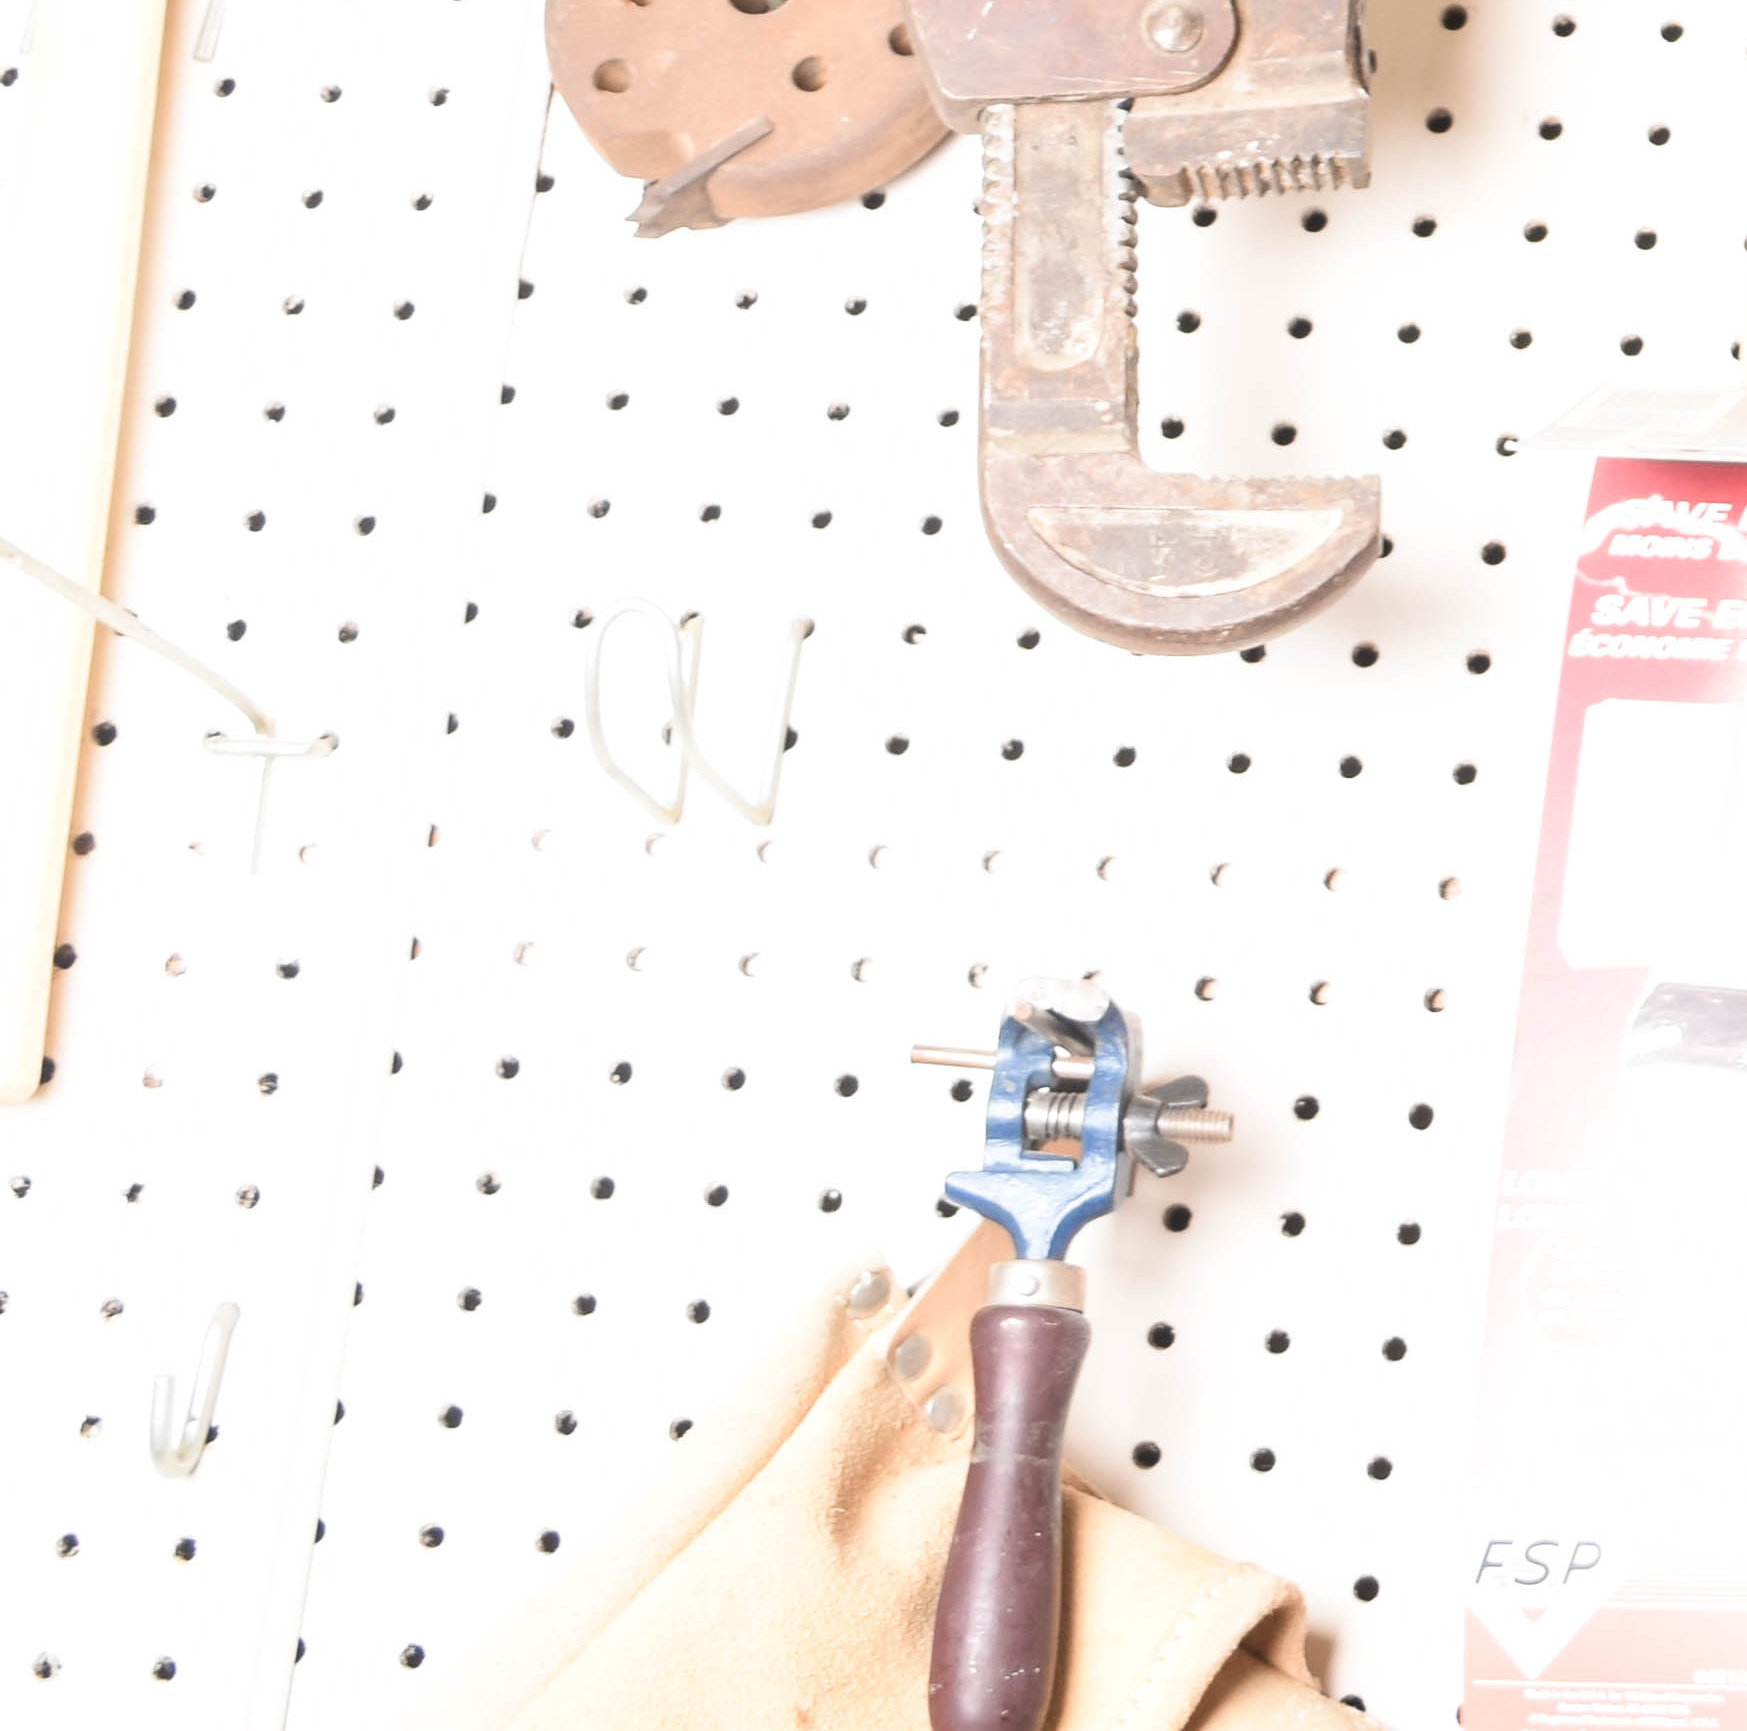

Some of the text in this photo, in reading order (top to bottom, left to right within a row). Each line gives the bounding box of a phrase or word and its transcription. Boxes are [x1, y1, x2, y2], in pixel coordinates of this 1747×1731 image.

[1608, 534, 1712, 560] MOINS
[1591, 594, 1708, 629] SAVE
[1476, 1539, 1603, 1586] FSP
